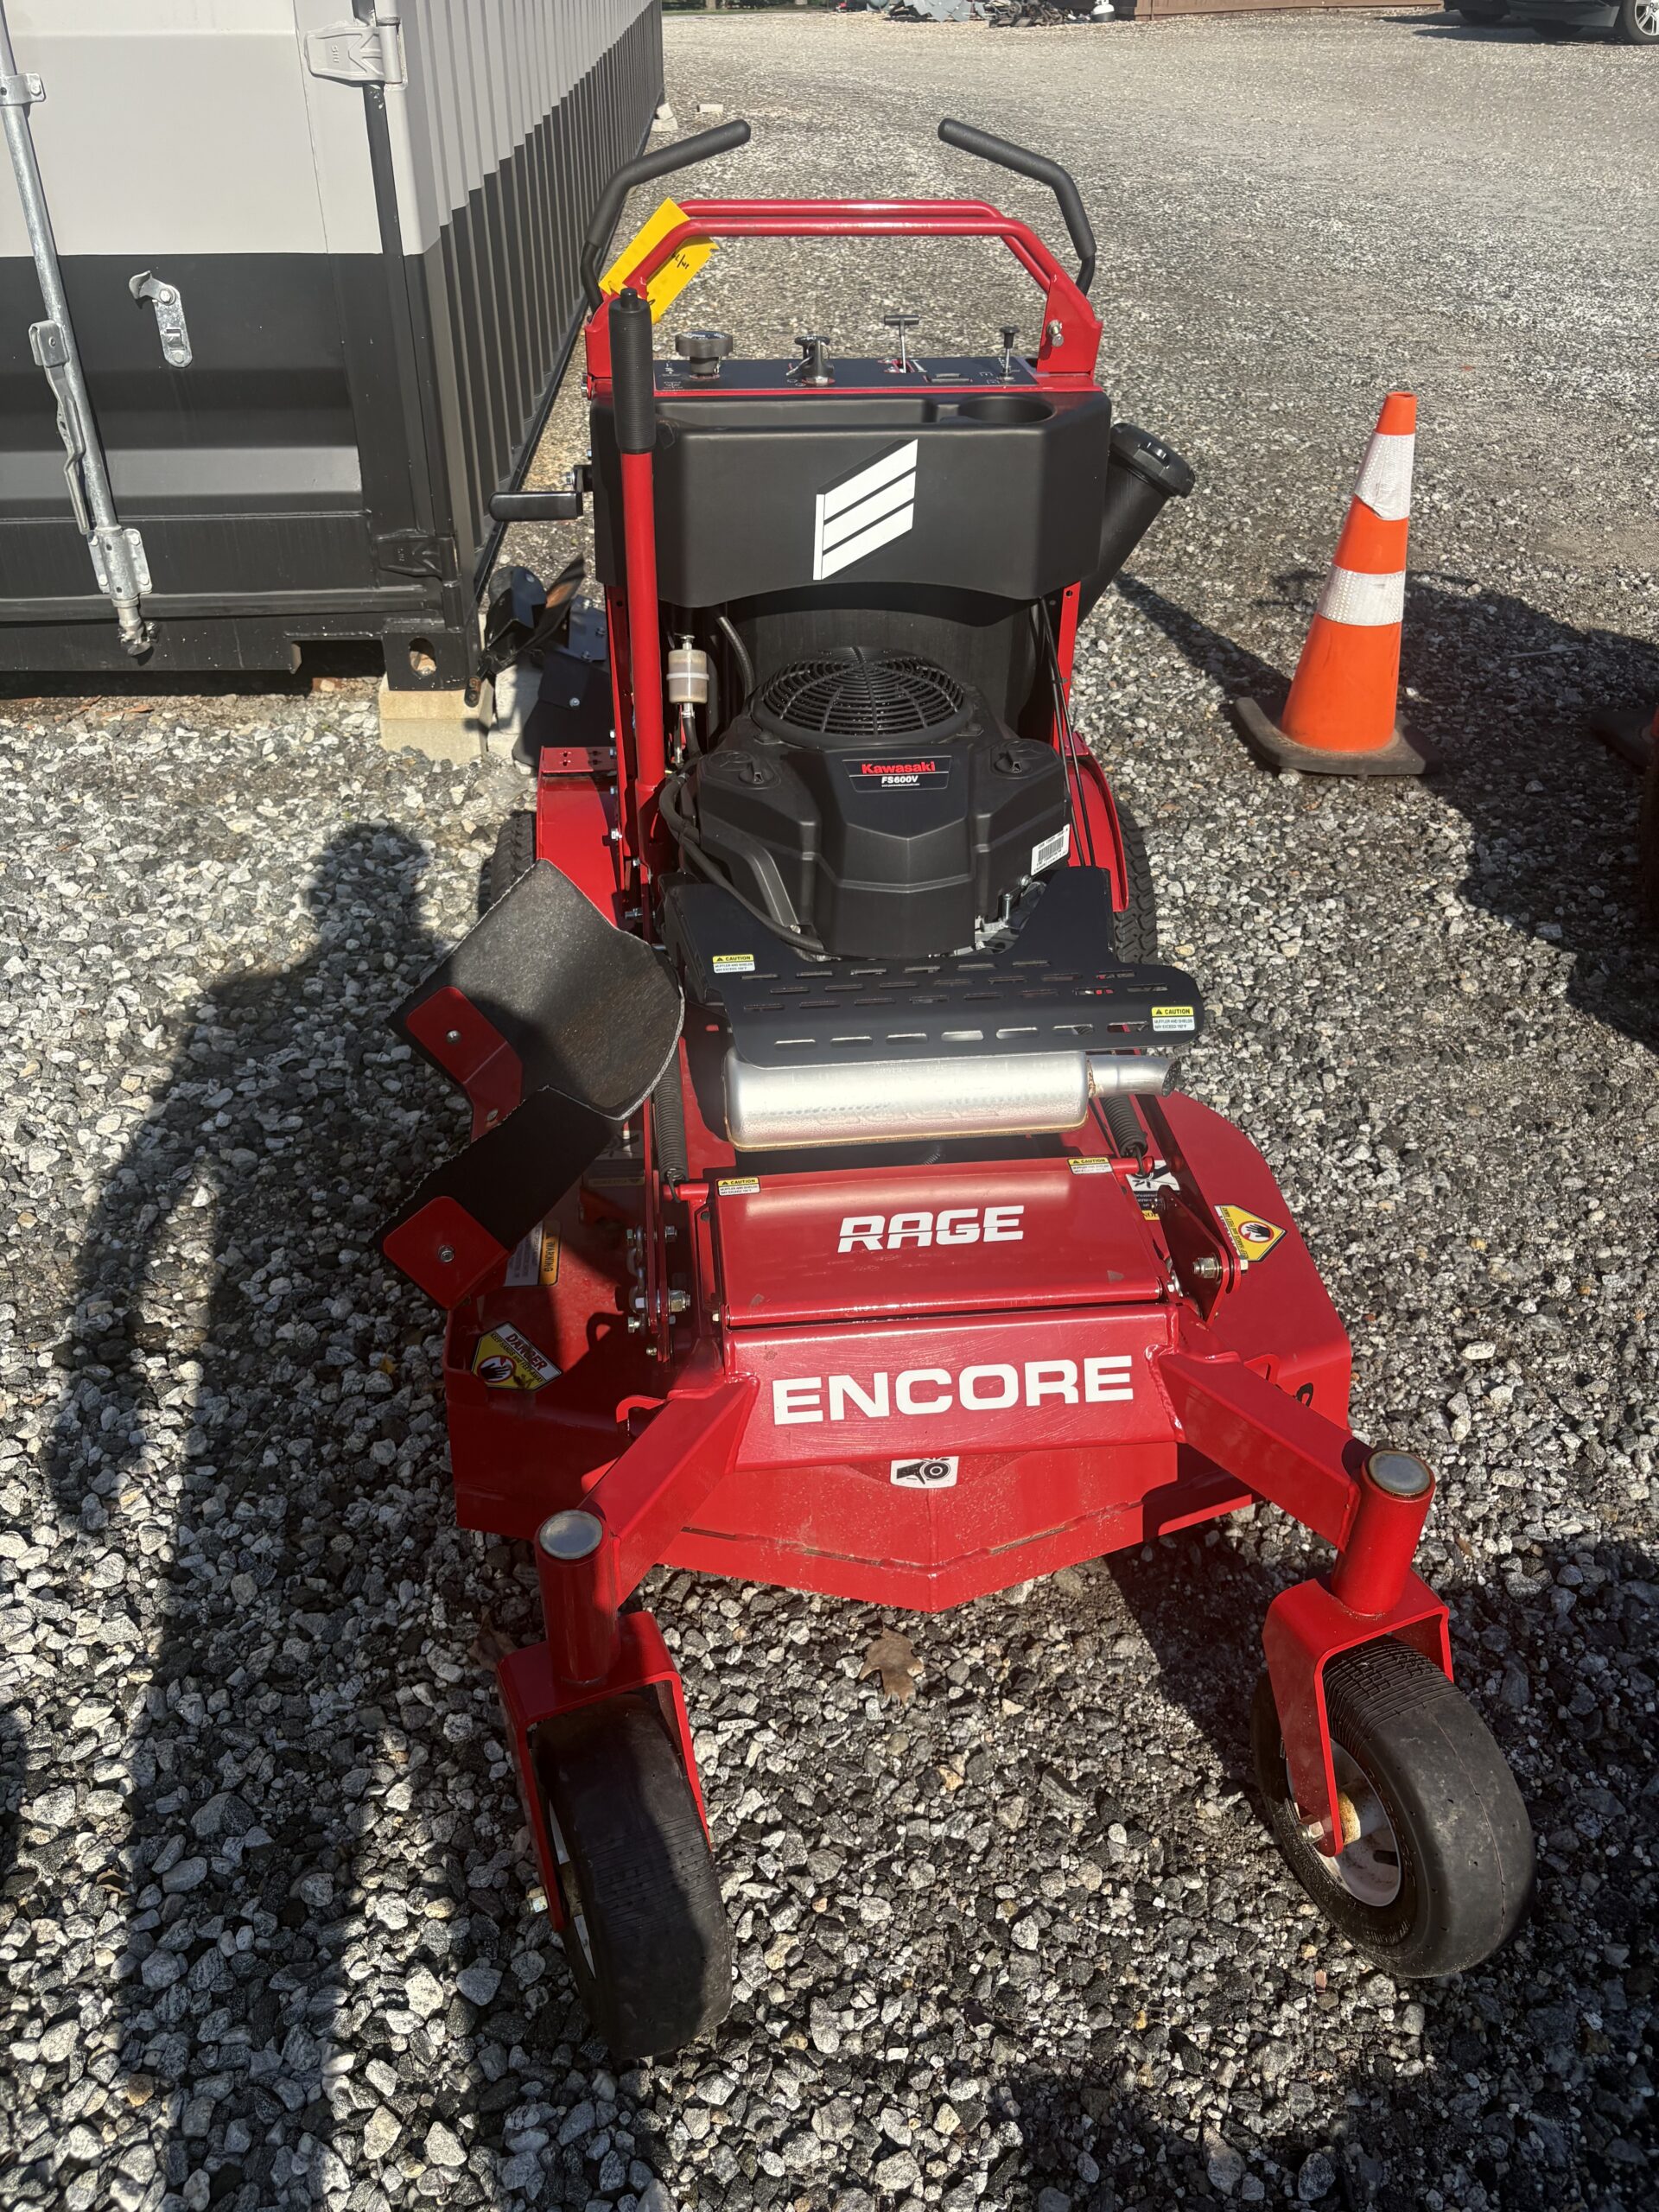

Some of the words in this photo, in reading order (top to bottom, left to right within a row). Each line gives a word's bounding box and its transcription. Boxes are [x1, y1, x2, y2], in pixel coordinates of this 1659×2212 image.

[861, 761, 936, 774] Kawasaki
[881, 775, 919, 784] FS600V
[837, 1205, 1025, 1253] RAGE
[543, 1242, 556, 1272] WARNING
[505, 1332, 548, 1370] DANGER
[772, 1355, 1134, 1426] ENCORE
